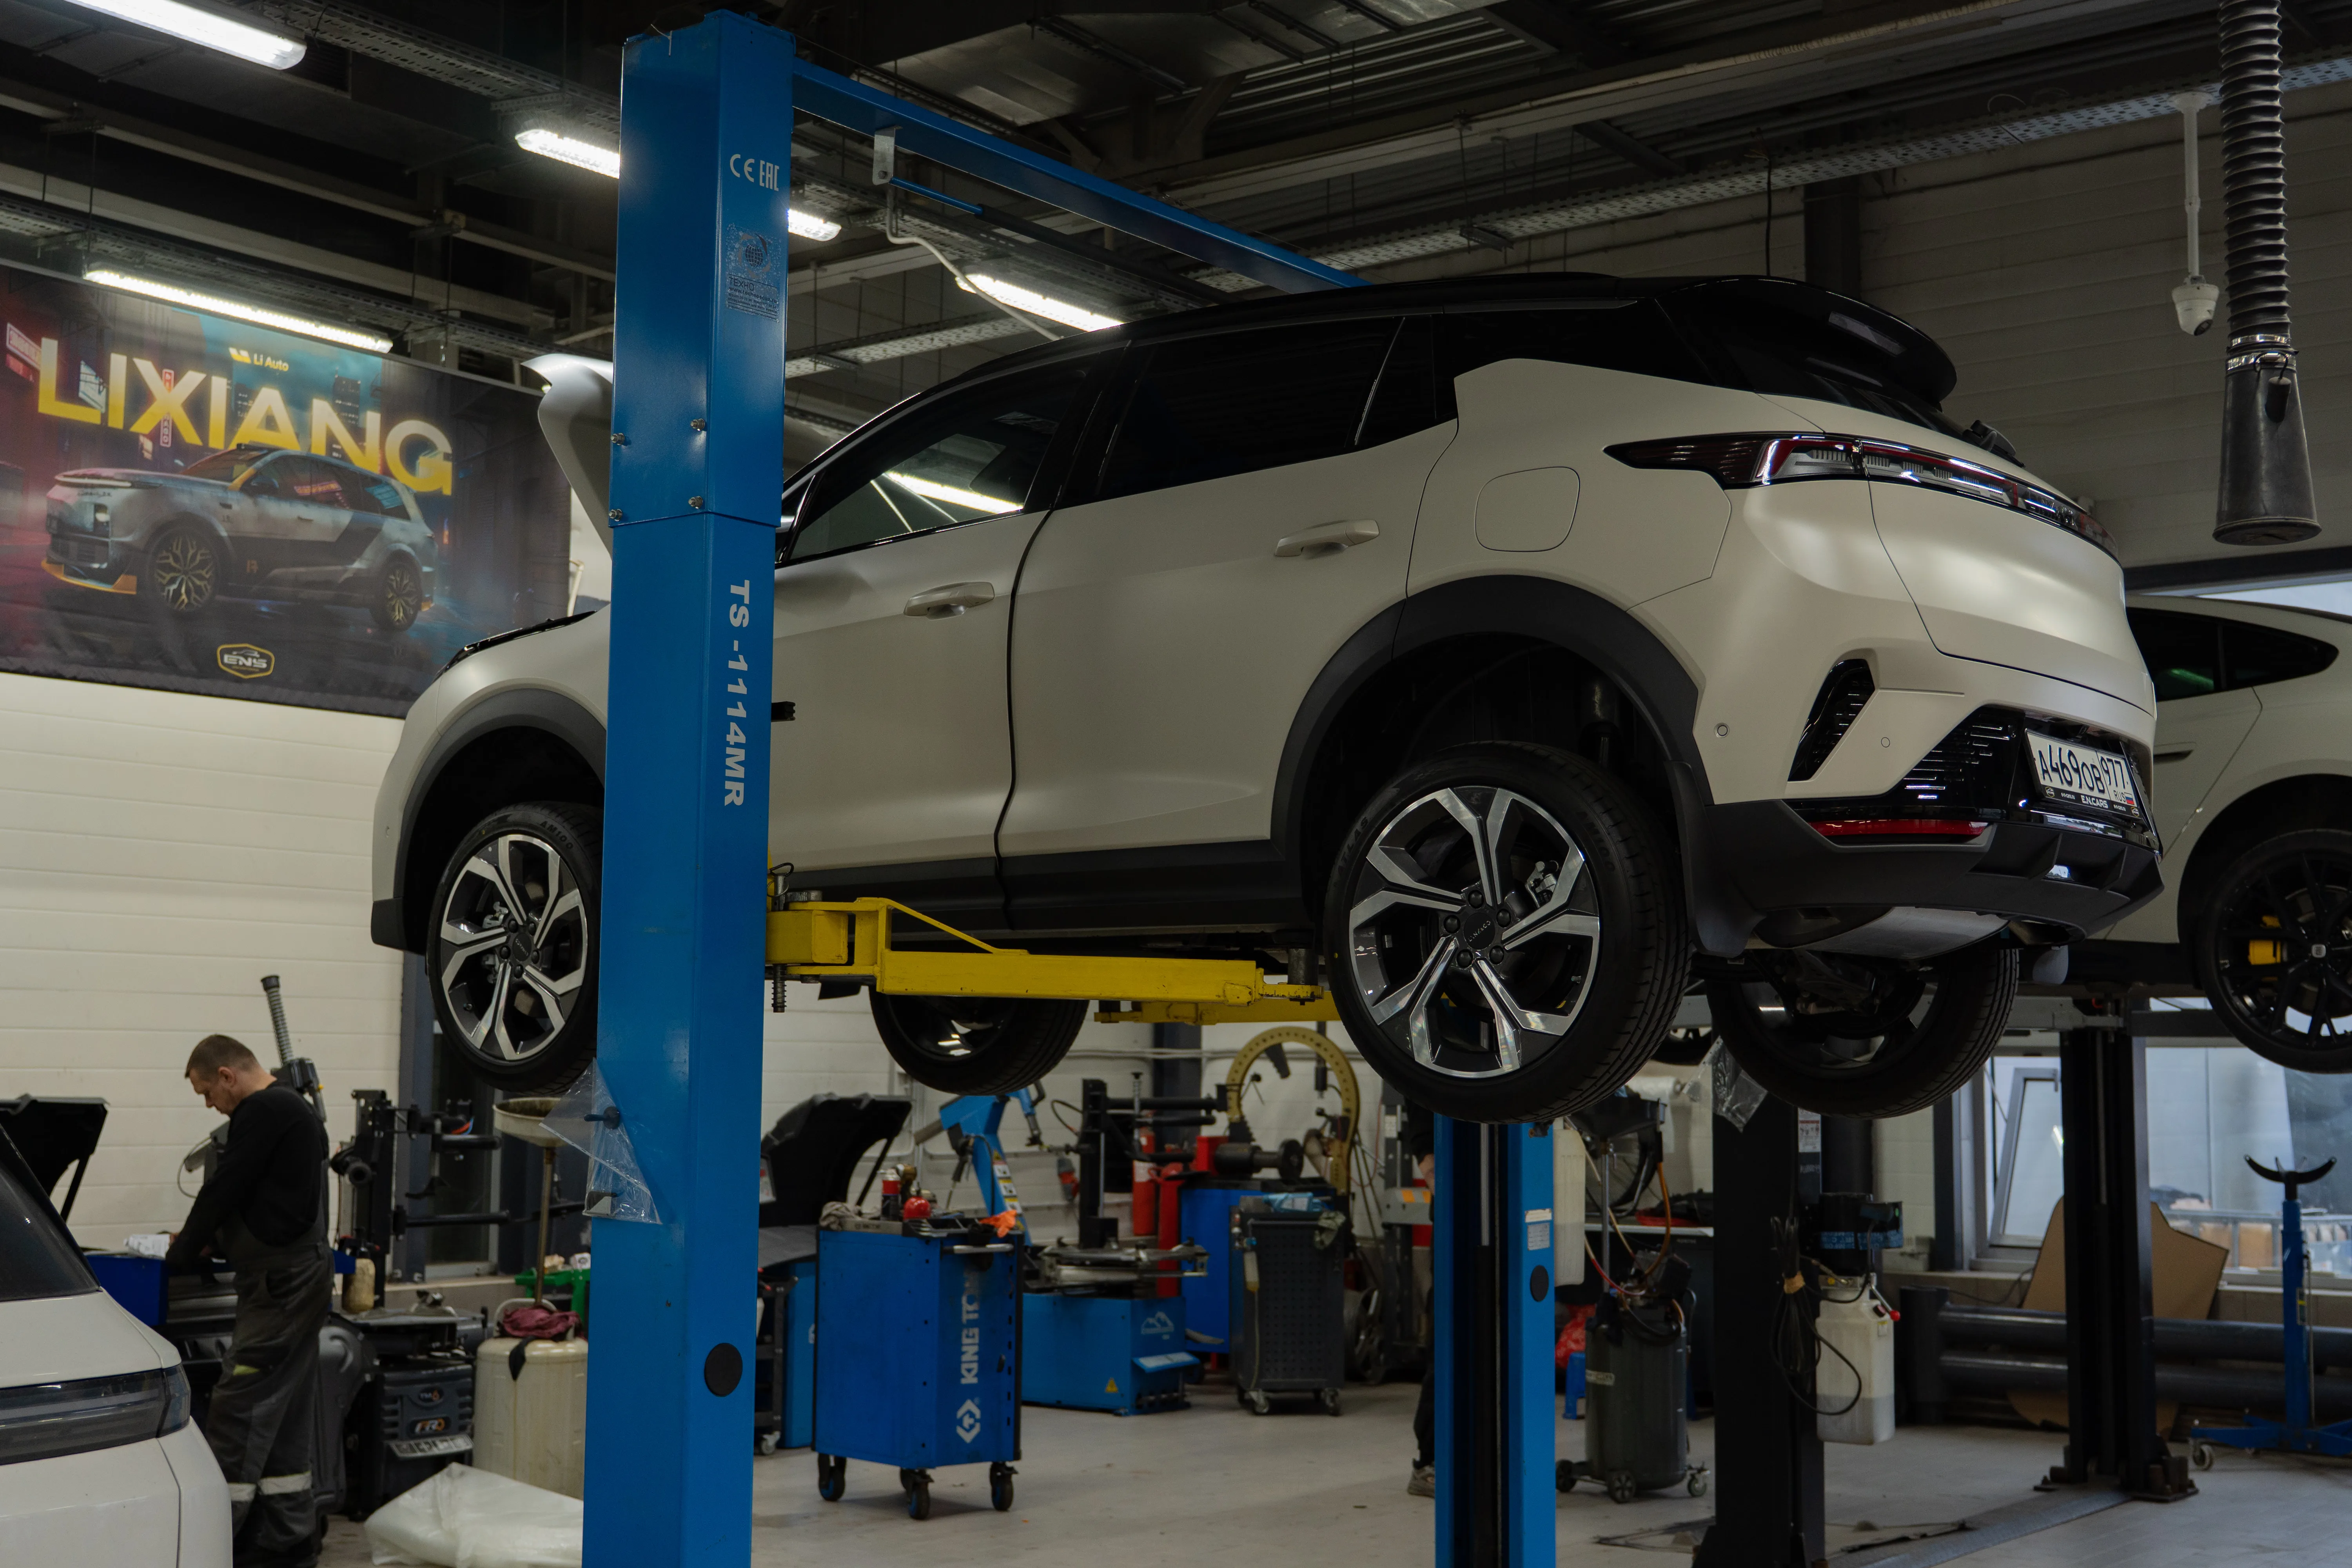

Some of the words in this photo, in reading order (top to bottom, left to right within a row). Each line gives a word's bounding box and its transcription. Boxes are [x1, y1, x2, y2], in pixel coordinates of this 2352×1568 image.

[254, 353, 263, 366] Li
[265, 356, 289, 372] Auto
[38, 337, 453, 496] LIXIANG
[223, 653, 267, 669] ENS
[2114, 790, 2125, 803] RUS
[960, 1327, 980, 1384] KING
